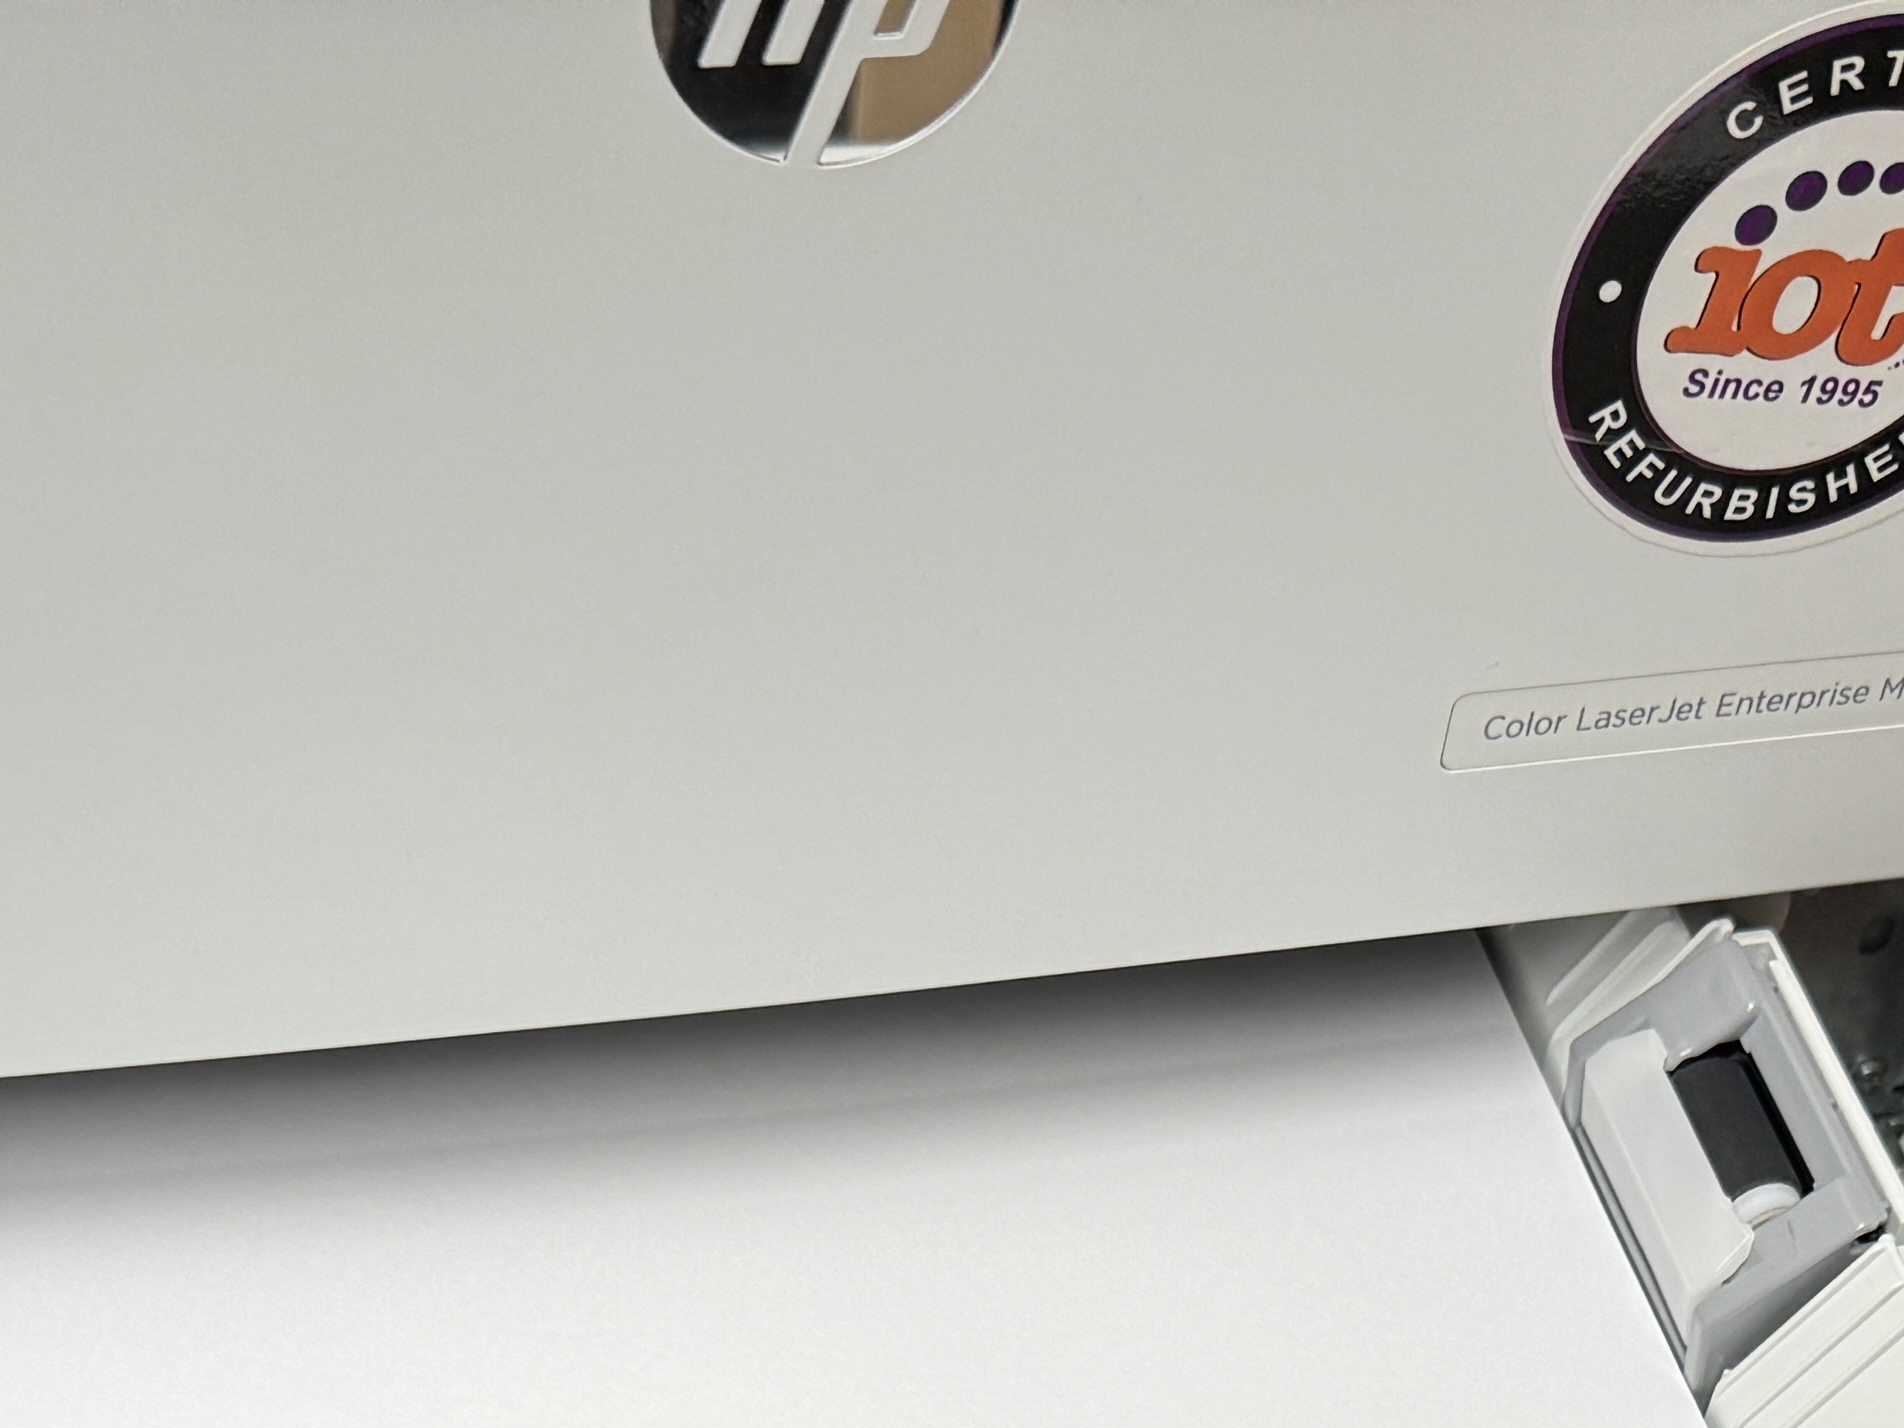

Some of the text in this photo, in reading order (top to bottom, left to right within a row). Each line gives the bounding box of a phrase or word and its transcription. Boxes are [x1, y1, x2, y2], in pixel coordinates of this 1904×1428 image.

[1682, 367, 1884, 409] Since 1995
[1483, 709, 1568, 741] Color
[1575, 698, 1707, 732] LaserJet
[1715, 681, 1870, 719] Enterprise
